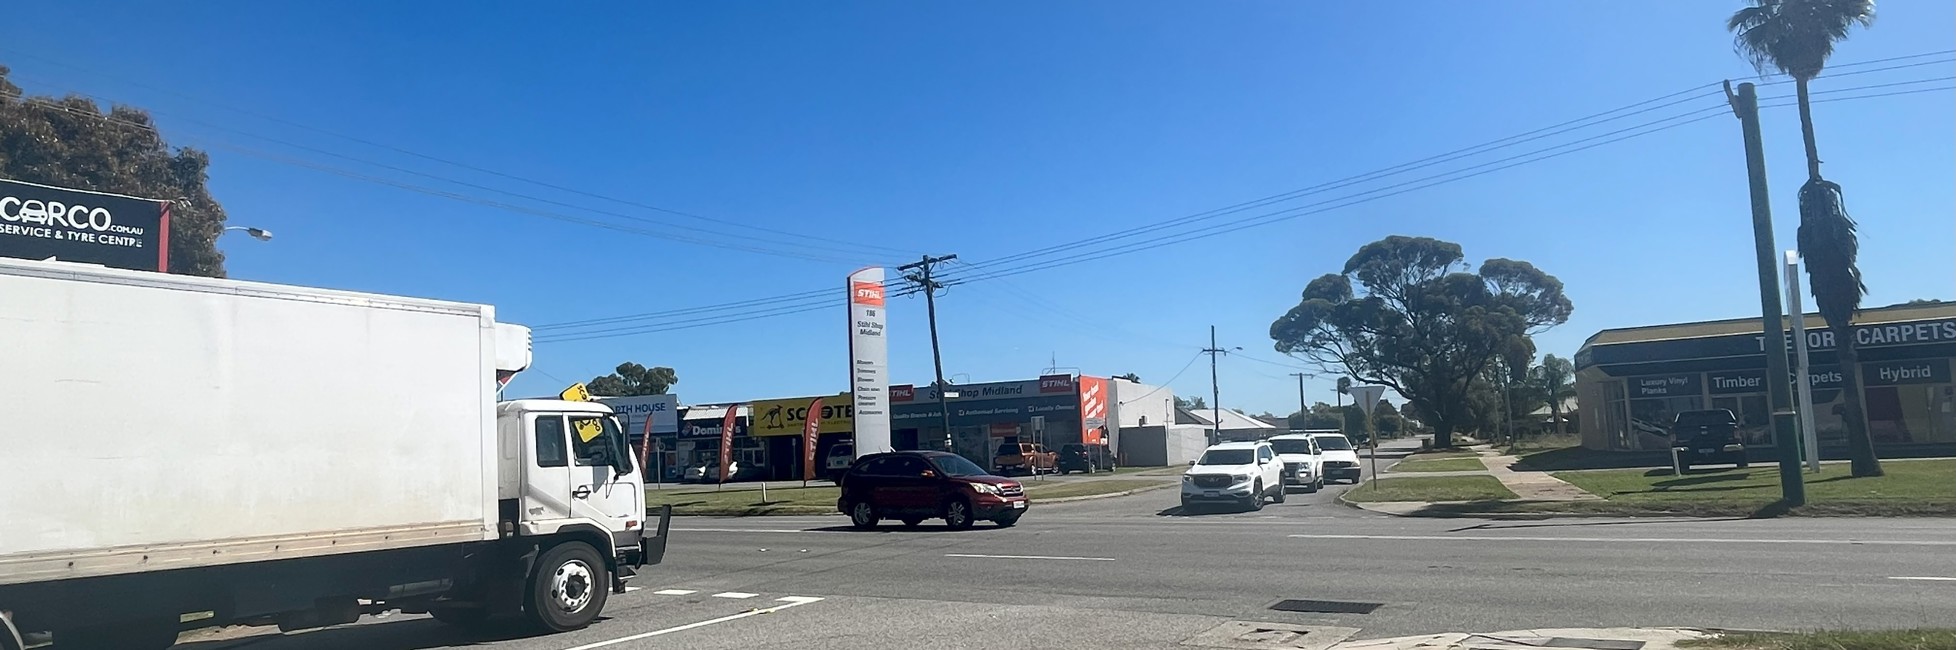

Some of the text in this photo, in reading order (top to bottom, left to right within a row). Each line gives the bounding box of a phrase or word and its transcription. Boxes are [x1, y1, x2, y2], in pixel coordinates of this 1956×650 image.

[0, 223, 143, 248] SERVICE & TYRE CENTRE
[858, 289, 882, 299] STIHL
[1755, 321, 1956, 351] TEOR CARPETS
[1879, 365, 1931, 382] Hybrid
[1041, 379, 1070, 388] STIHL
[1640, 376, 1688, 388] Luxury Vinyl
[1713, 376, 1761, 389] Timber
[982, 384, 1023, 396] Midland
[1641, 387, 1668, 395] Planks
[635, 402, 666, 413] HOUSE
[808, 417, 819, 462] STIHL
